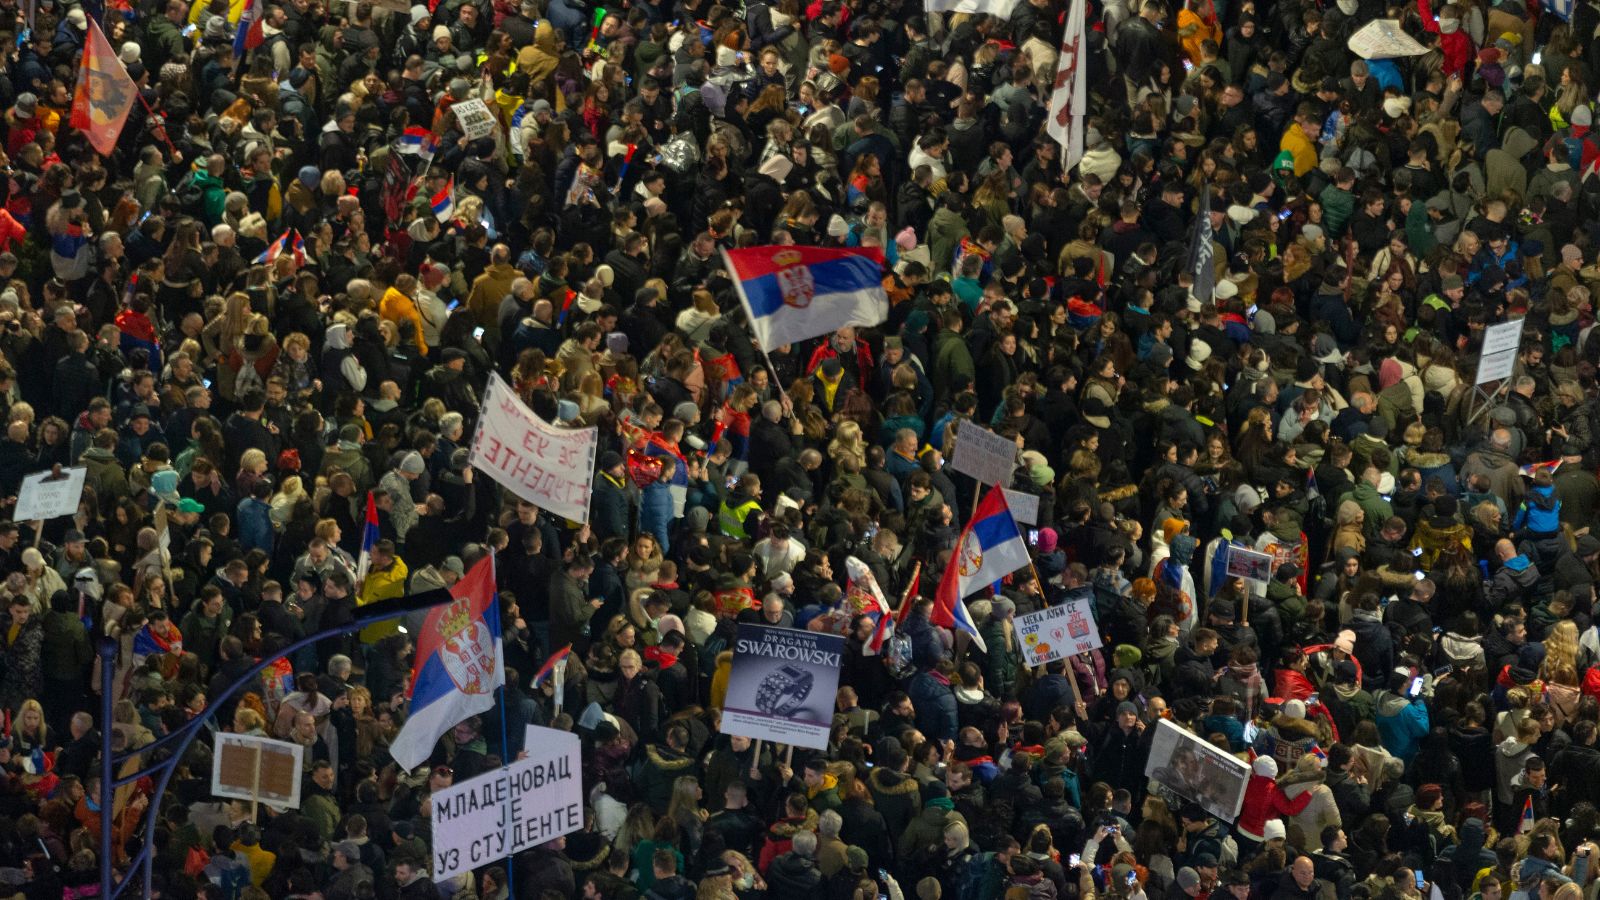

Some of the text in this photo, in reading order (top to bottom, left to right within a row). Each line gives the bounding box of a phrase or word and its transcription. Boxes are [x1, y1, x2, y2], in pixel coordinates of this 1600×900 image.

[1022, 613, 1044, 626] НЕКА
[1067, 603, 1077, 614] СЕ
[764, 634, 817, 649] DRAGANA
[1021, 625, 1040, 636] СЕВЕР
[736, 639, 841, 667] SWAROWSKI
[437, 755, 572, 824] МЛАДЕНОВАЦ
[497, 798, 522, 828] ЈЕ
[438, 803, 579, 875] УЗ СТУДЕНТЕ
